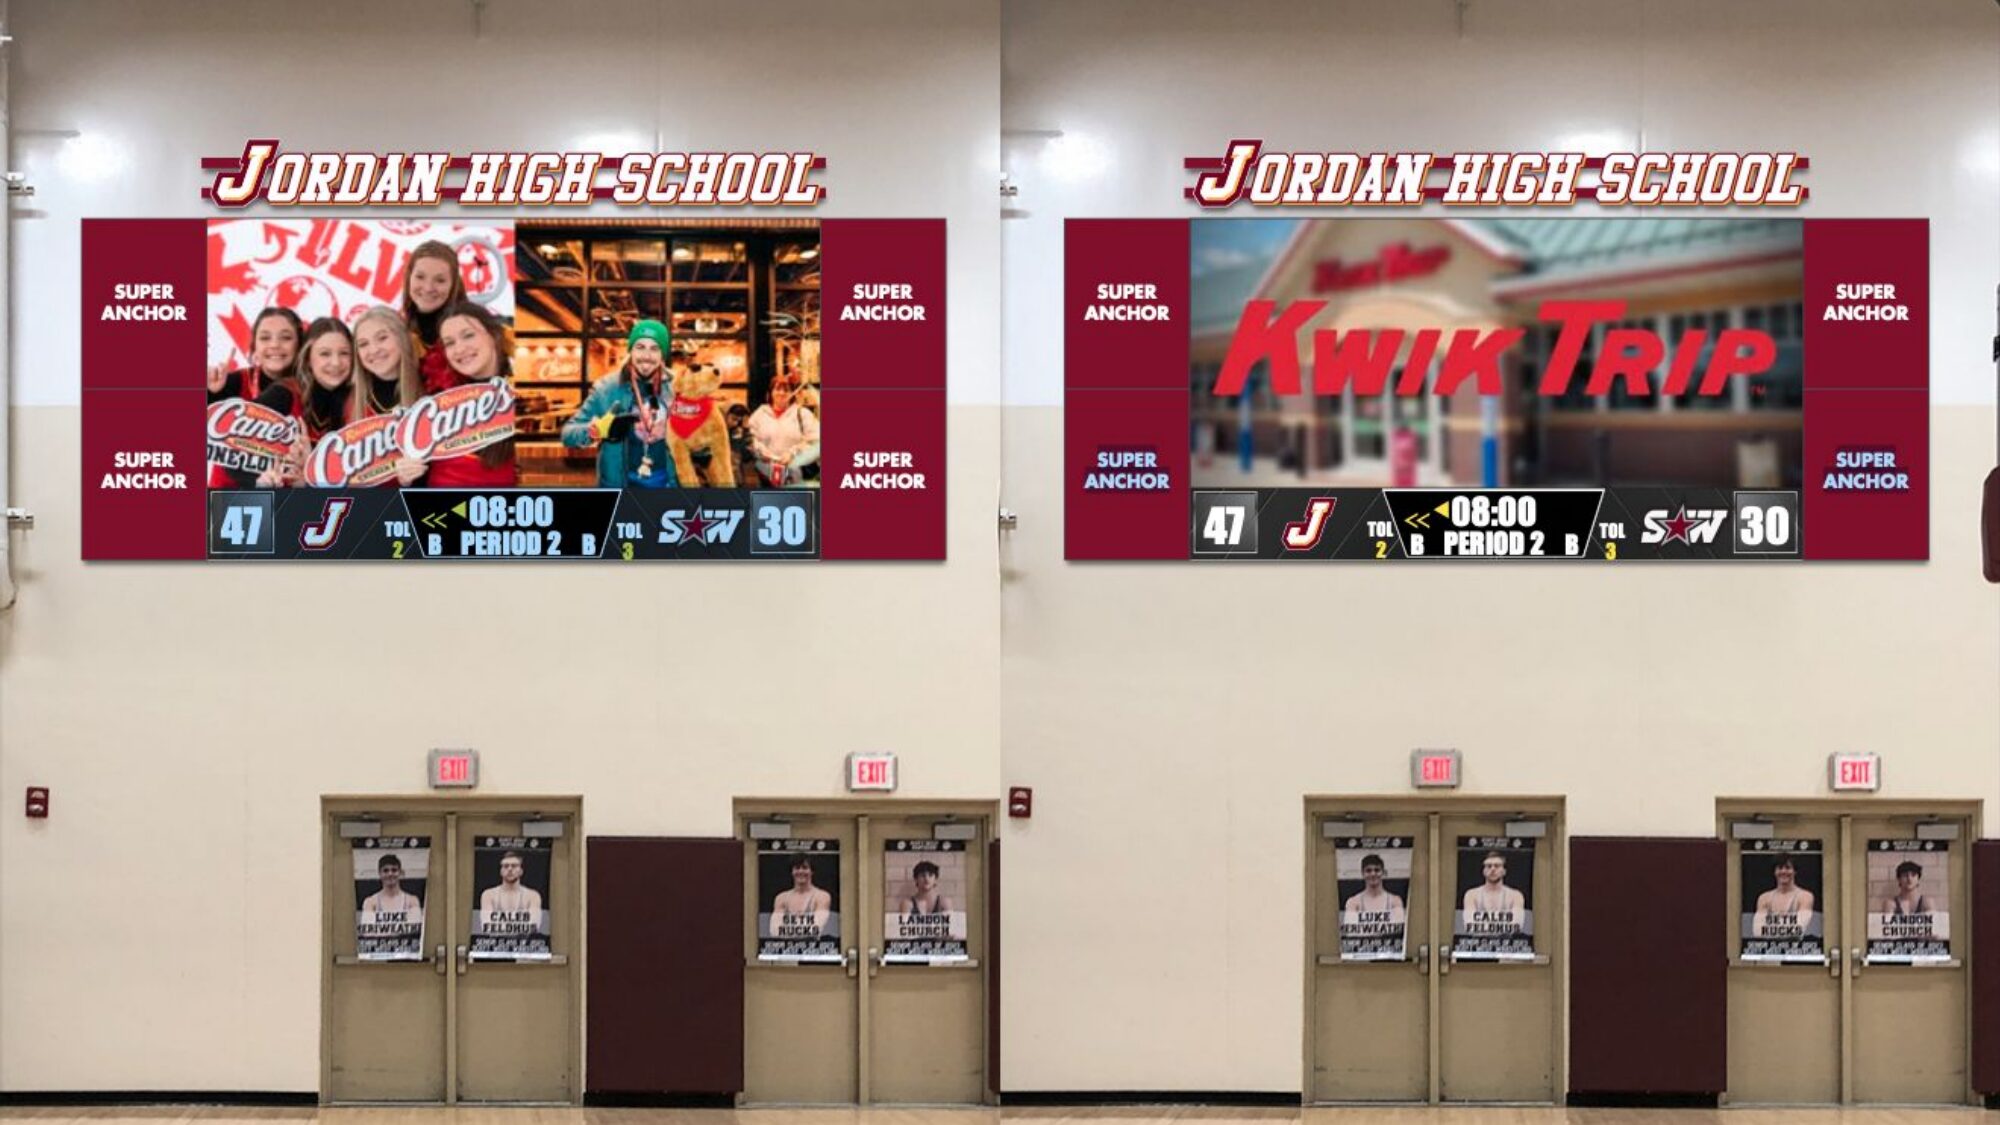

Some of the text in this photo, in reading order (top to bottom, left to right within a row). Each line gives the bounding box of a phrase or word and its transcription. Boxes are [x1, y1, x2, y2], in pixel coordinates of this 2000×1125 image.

[211, 140, 819, 207] JORDAN HIGH SCHOOL
[1192, 140, 1802, 207] JORDAN HIGH SCHOOL
[114, 283, 175, 299] SUPER
[853, 283, 913, 299] SUPER
[1097, 283, 1157, 299] SUPER
[1836, 283, 1896, 299] SUPER
[100, 304, 187, 321] ANCHOR
[840, 304, 926, 321] ANCHOR
[1084, 304, 1170, 321] ANCHOR
[1823, 304, 1909, 321] ANCHOR
[1537, 299, 1777, 396] TRIP
[114, 451, 175, 467] SUPER
[853, 451, 913, 467] SUPER
[1097, 451, 1157, 467] SUPER
[1836, 451, 1896, 467] SUPER
[100, 472, 187, 489] ANCHOR
[840, 472, 926, 489] ANCHOR
[1084, 472, 1170, 489] ANCHOR
[1823, 472, 1909, 489] ANCHOR
[469, 495, 553, 527] 08:00
[1452, 495, 1537, 527] 08:00
[220, 506, 263, 545] 47
[301, 499, 352, 549] J
[384, 521, 411, 538] TOL
[616, 522, 643, 539] TOL
[758, 505, 806, 545] 30
[1203, 506, 1245, 545] 47
[1284, 499, 1335, 549] J
[1367, 521, 1394, 538] TOL
[1600, 522, 1625, 539] TOL
[1740, 505, 1789, 545] 30
[392, 541, 404, 559] 2
[428, 533, 442, 556] B
[460, 531, 561, 556] PERIOD 2
[581, 533, 596, 556] B
[622, 542, 634, 560] 3
[1375, 541, 1387, 559] 2
[1410, 533, 1425, 556] B
[1444, 531, 1545, 556] PERIOD 2
[1565, 533, 1579, 556] B
[1605, 542, 1617, 560] 3
[439, 757, 468, 781] EXIT
[858, 761, 888, 783] EXIT
[1422, 757, 1451, 781] EXIT
[1840, 761, 1871, 784] EXIT
[376, 912, 408, 922] LUKE
[490, 911, 530, 922] CALEB
[783, 915, 814, 925] SETH
[899, 915, 950, 925] LANDON
[1358, 912, 1391, 922] LUKE
[1473, 911, 1513, 922] CALEB
[1765, 915, 1797, 925] SETH
[1882, 915, 1933, 925] LANDON
[900, 926, 950, 936] CHURCH
[1882, 926, 1932, 936] CHURCH
